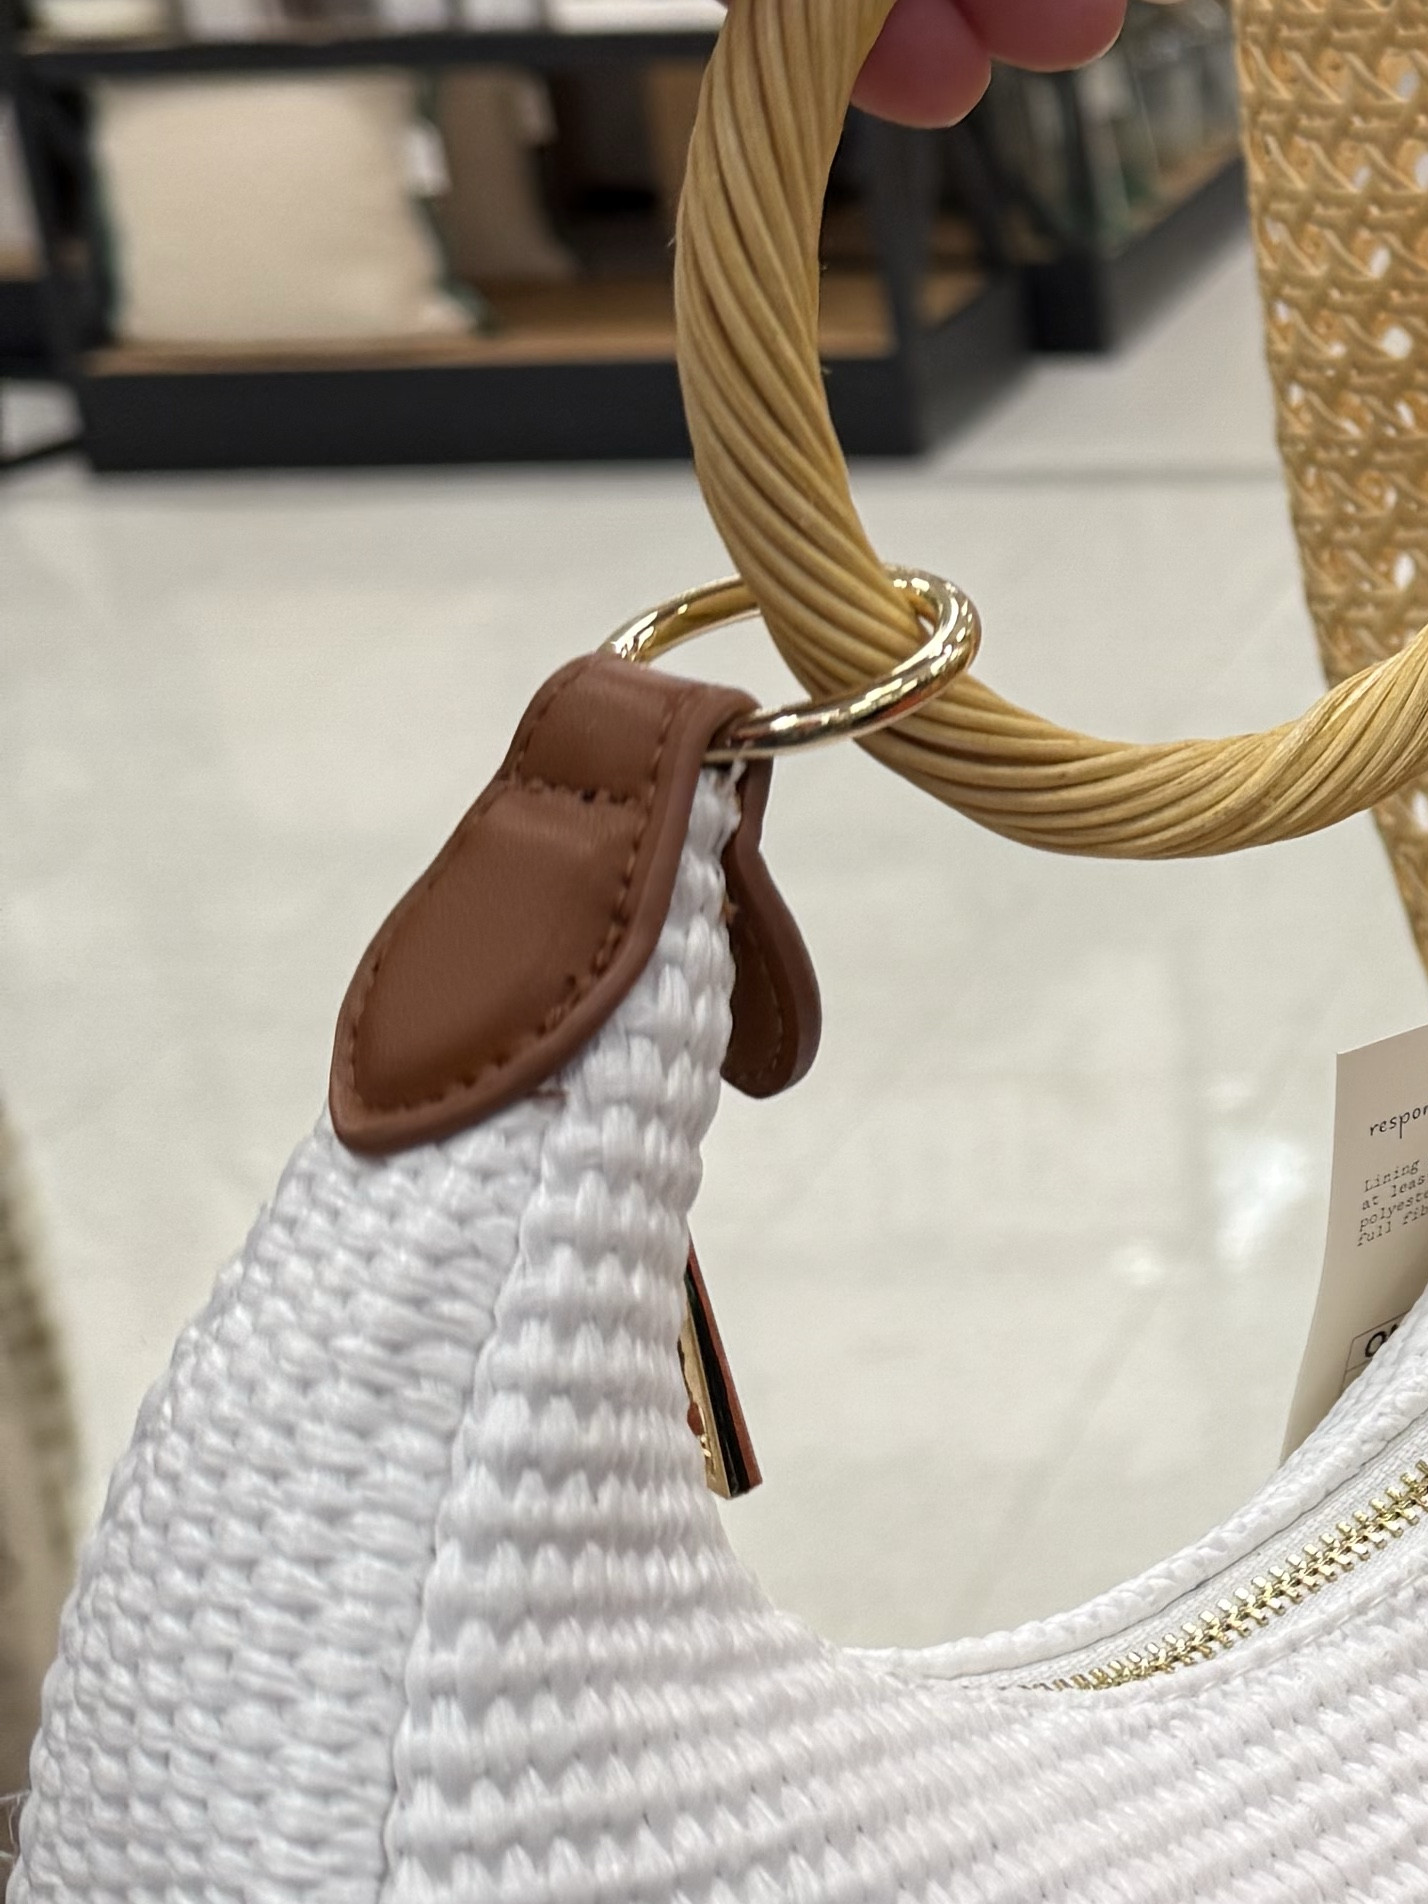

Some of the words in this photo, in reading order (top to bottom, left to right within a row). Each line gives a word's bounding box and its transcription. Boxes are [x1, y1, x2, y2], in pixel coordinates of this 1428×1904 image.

[1364, 1159, 1420, 1192] Lining
[1361, 1195, 1379, 1211] at
[1356, 1220, 1392, 1247] full
